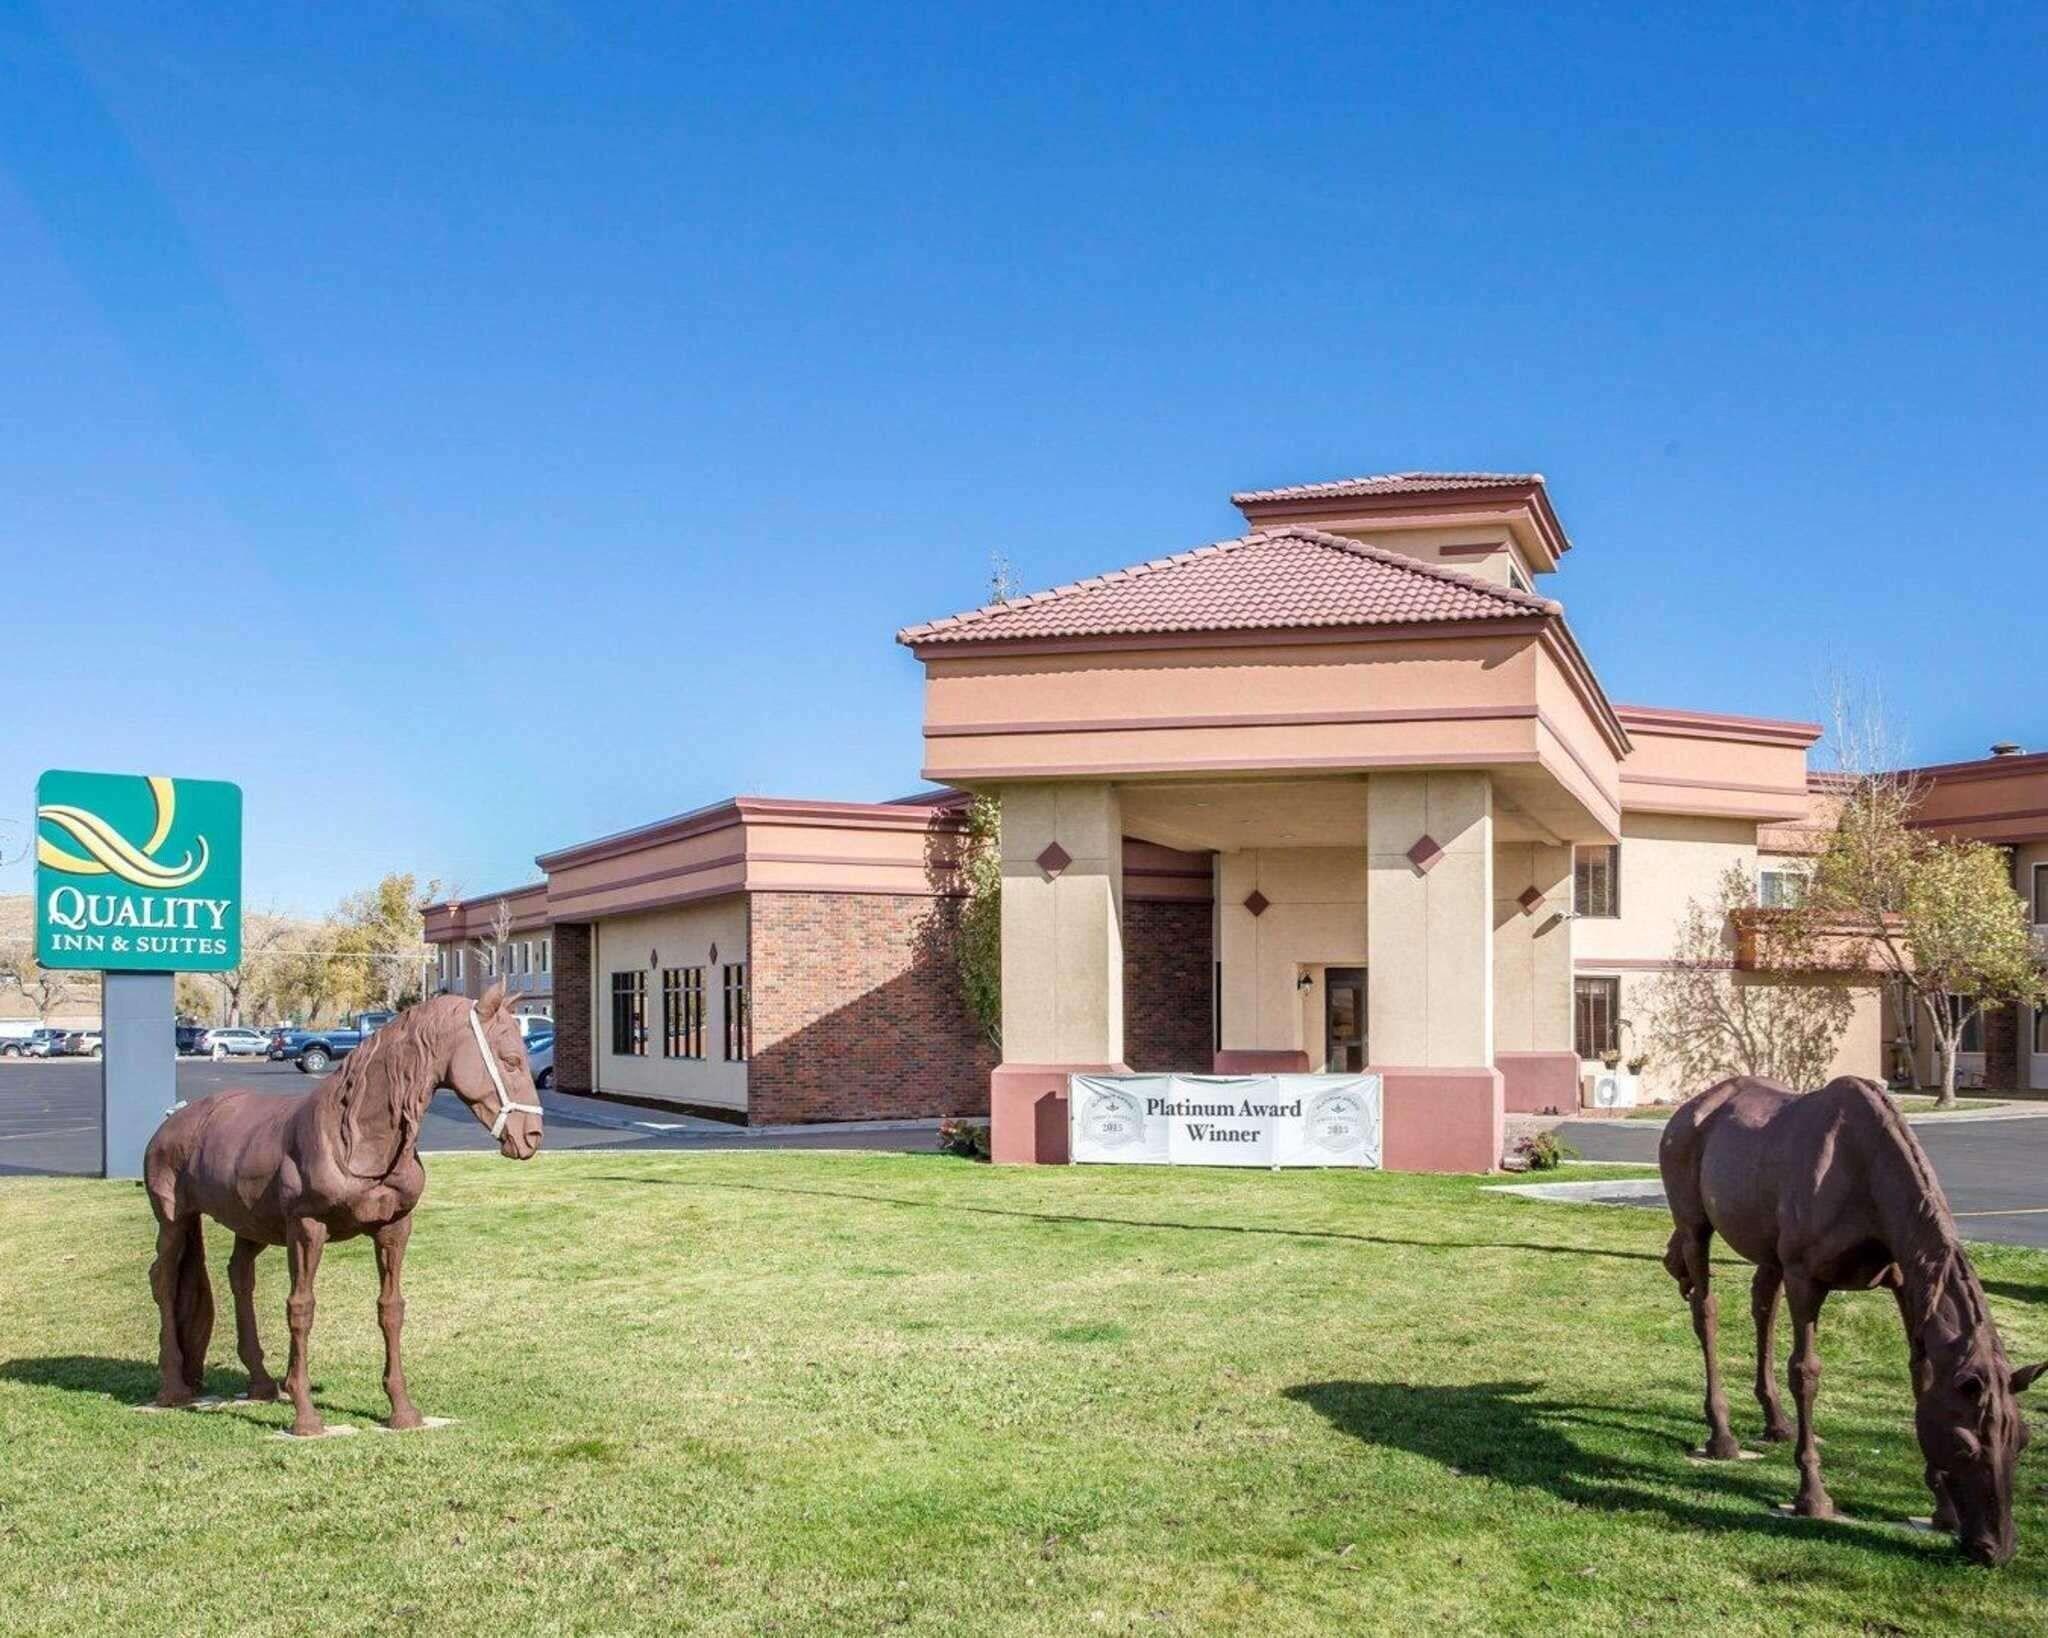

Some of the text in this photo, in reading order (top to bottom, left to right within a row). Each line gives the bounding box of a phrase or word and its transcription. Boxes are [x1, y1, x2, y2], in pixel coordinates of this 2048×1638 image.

[48, 886, 231, 930] QUALITY
[52, 934, 227, 955] INN & SUITES
[1146, 1098, 1235, 1116] Platinum
[1238, 1099, 1303, 1117] Award
[1186, 1123, 1261, 1142] Winner
